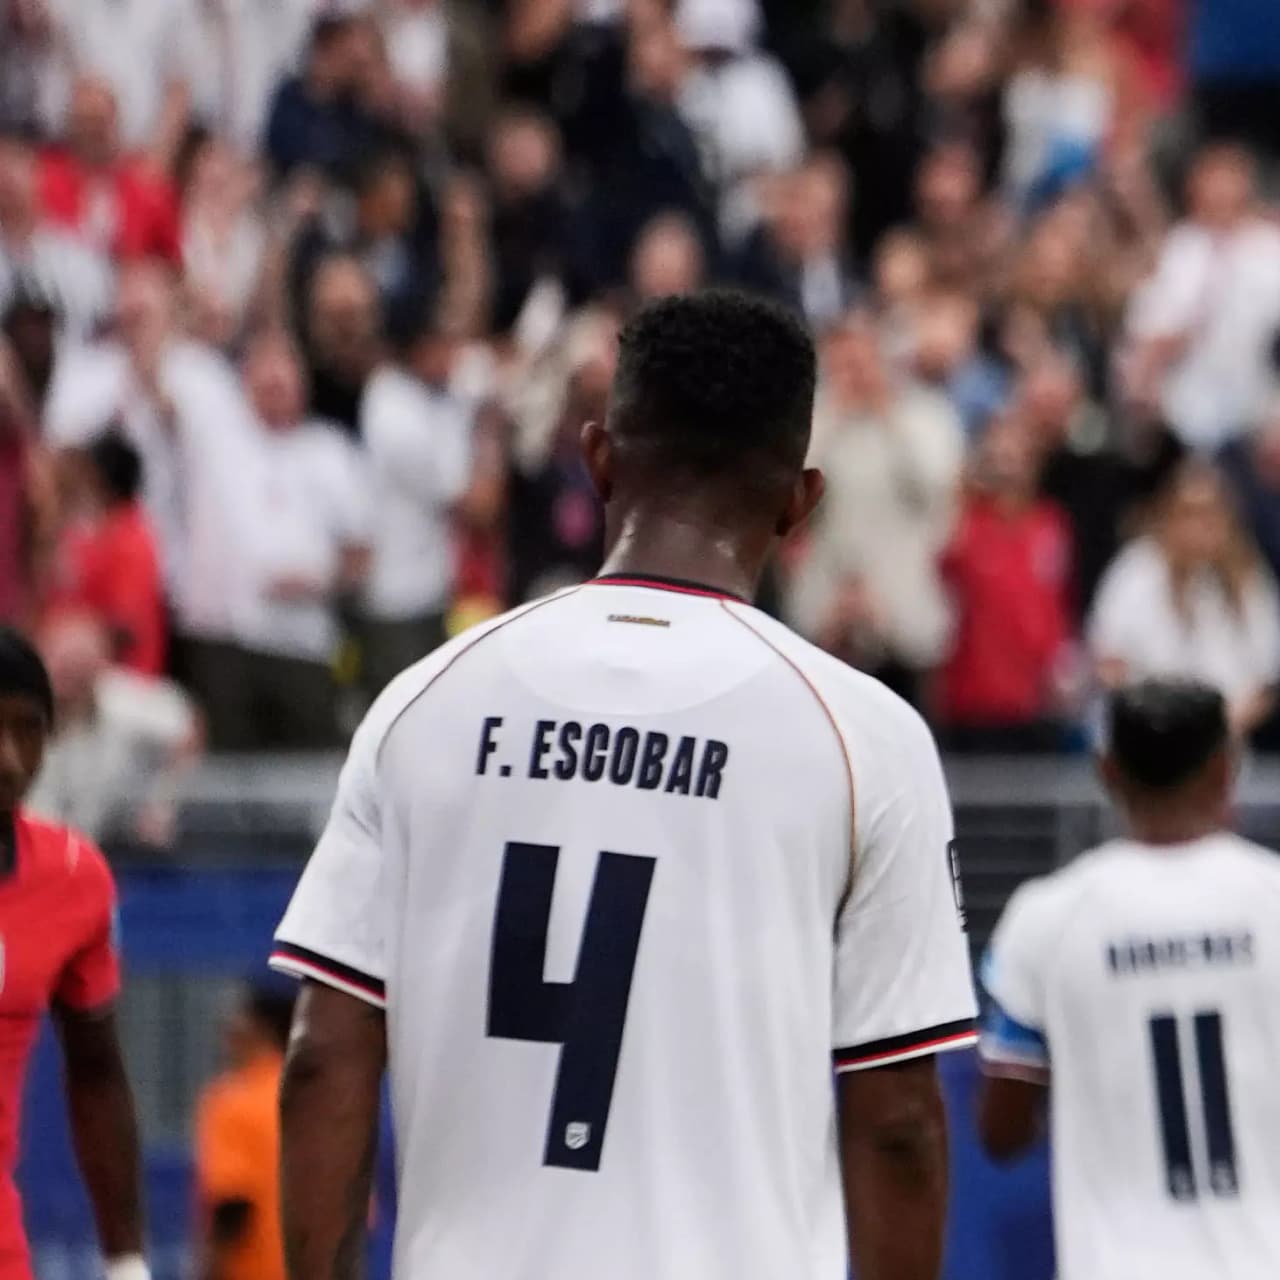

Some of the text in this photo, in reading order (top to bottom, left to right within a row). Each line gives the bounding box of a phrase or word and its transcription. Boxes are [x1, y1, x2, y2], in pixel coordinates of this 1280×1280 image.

[476, 716, 729, 800] F. ESCOBAR
[485, 841, 657, 1172] 4
[1146, 1008, 1240, 1202] 11
